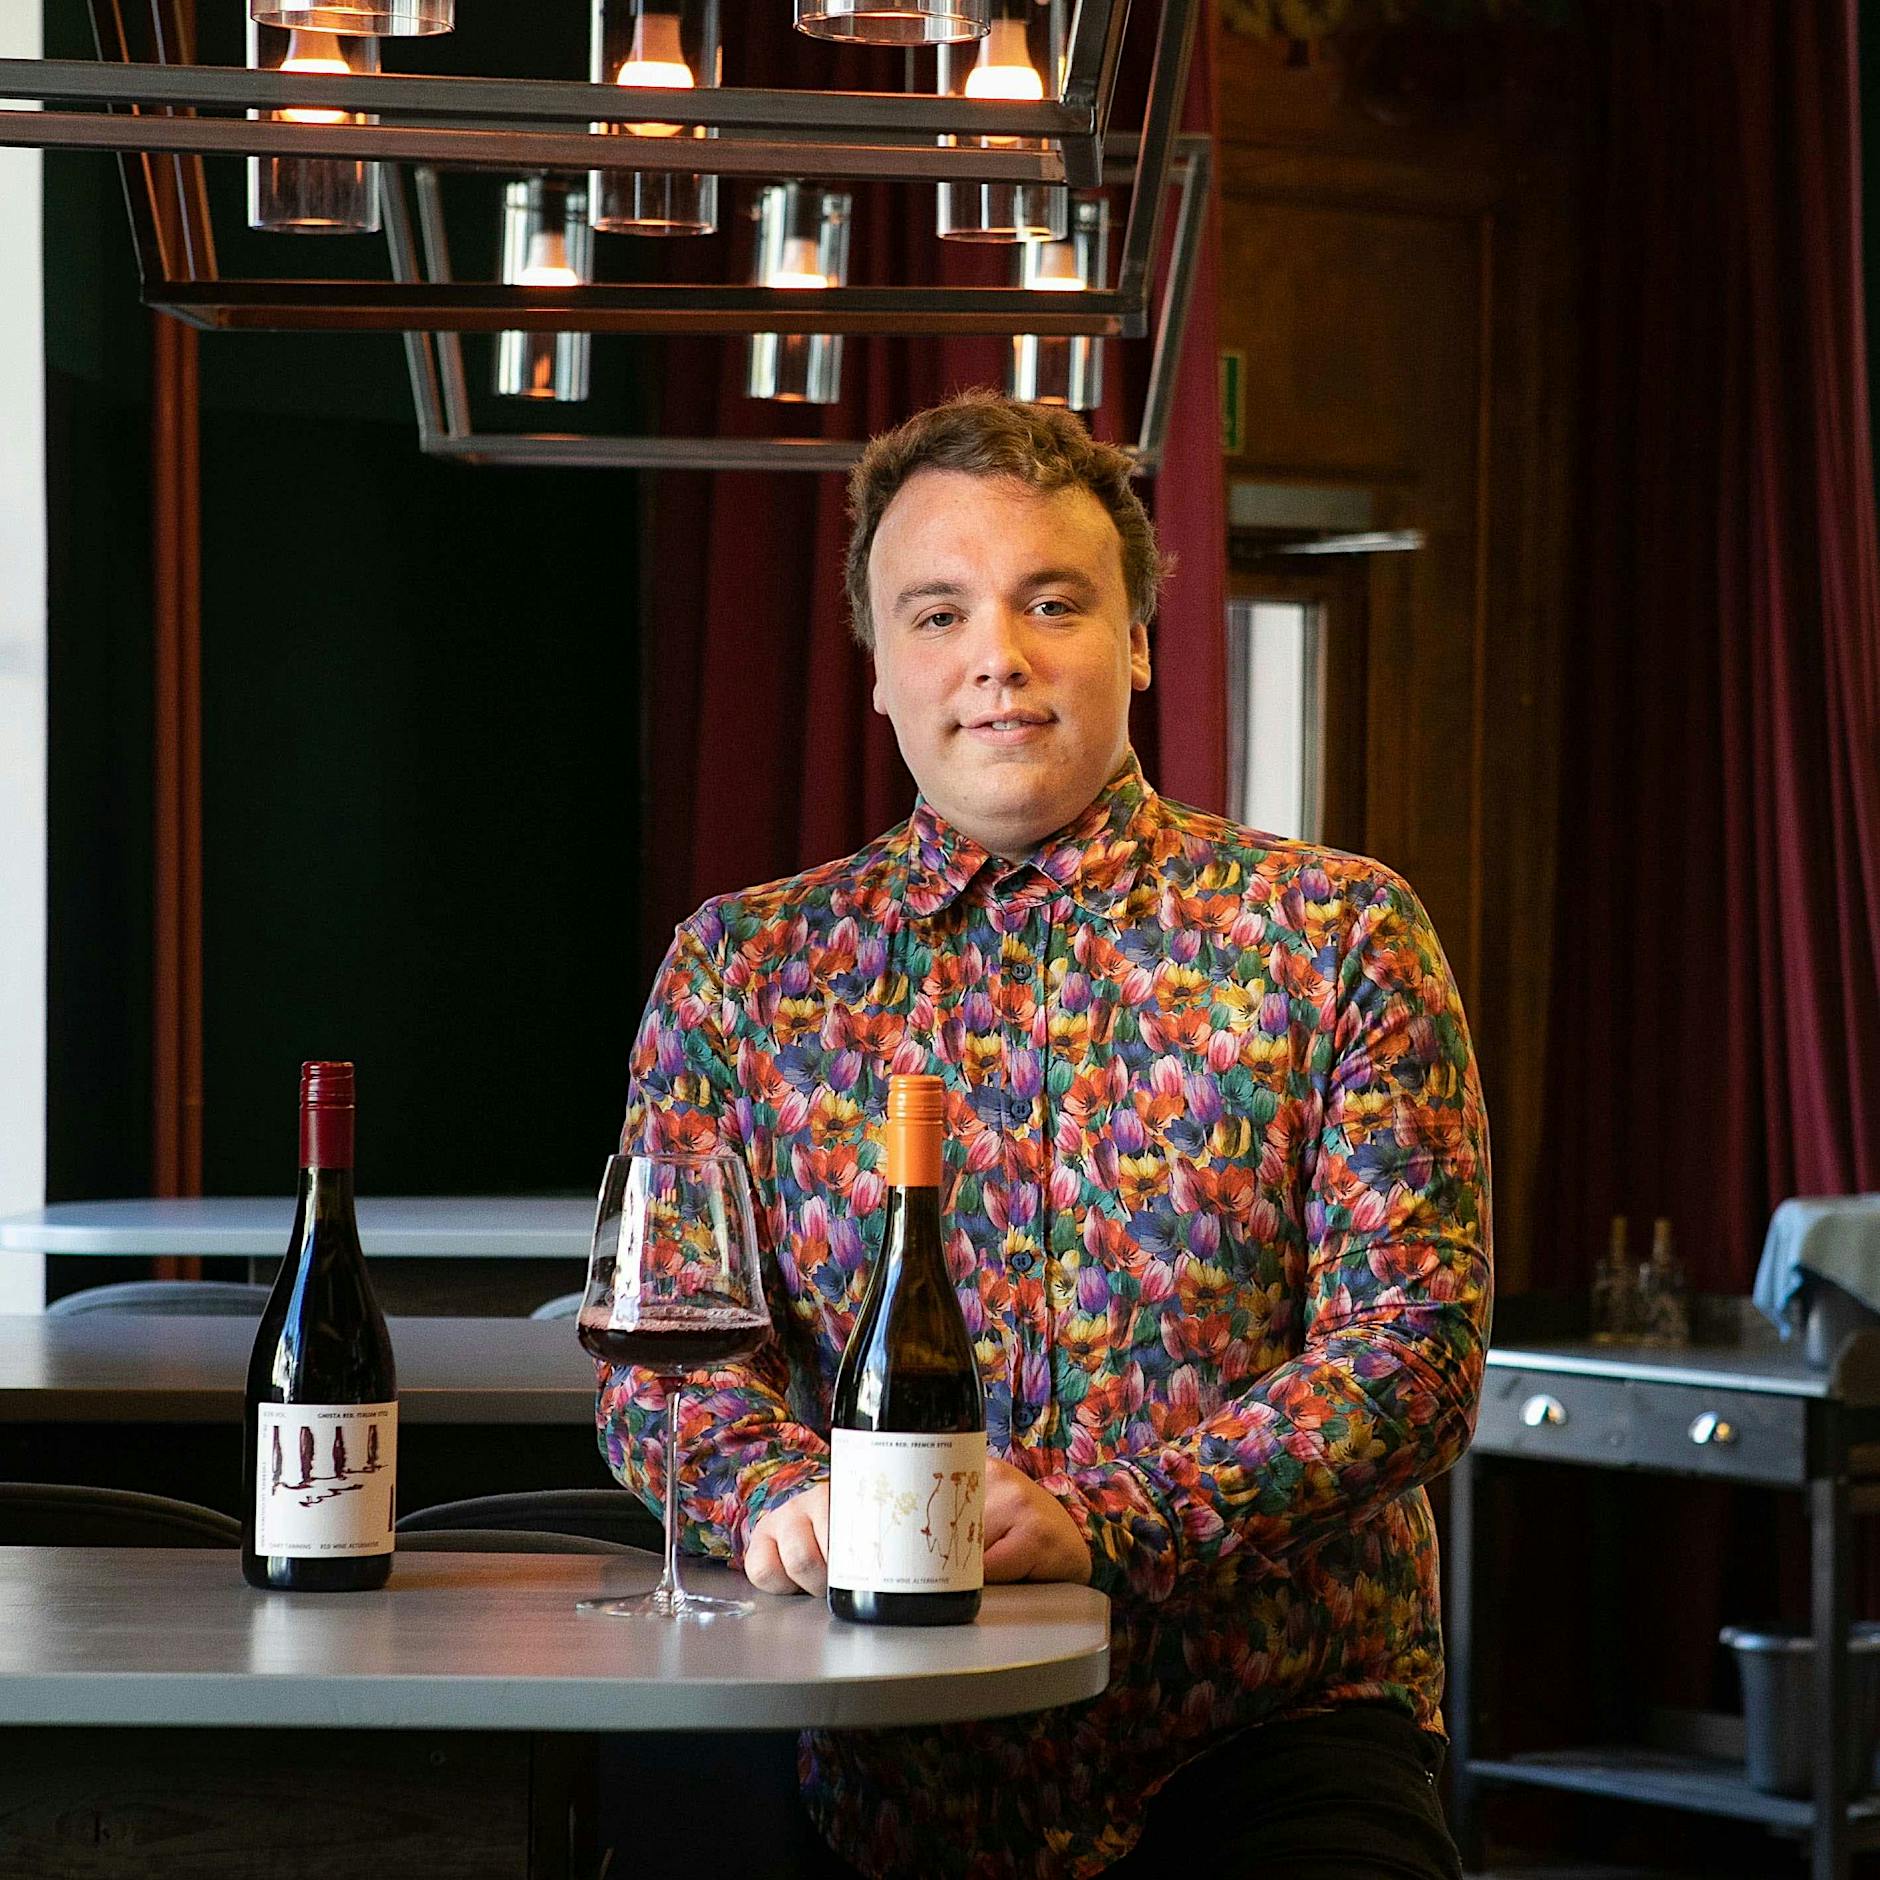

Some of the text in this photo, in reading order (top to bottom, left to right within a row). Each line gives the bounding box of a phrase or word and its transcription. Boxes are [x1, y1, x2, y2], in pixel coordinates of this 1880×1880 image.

[911, 1441, 935, 1449] FRENCH
[937, 1441, 953, 1449] STYLE
[912, 1577, 949, 1585] ALTERNATIVE
